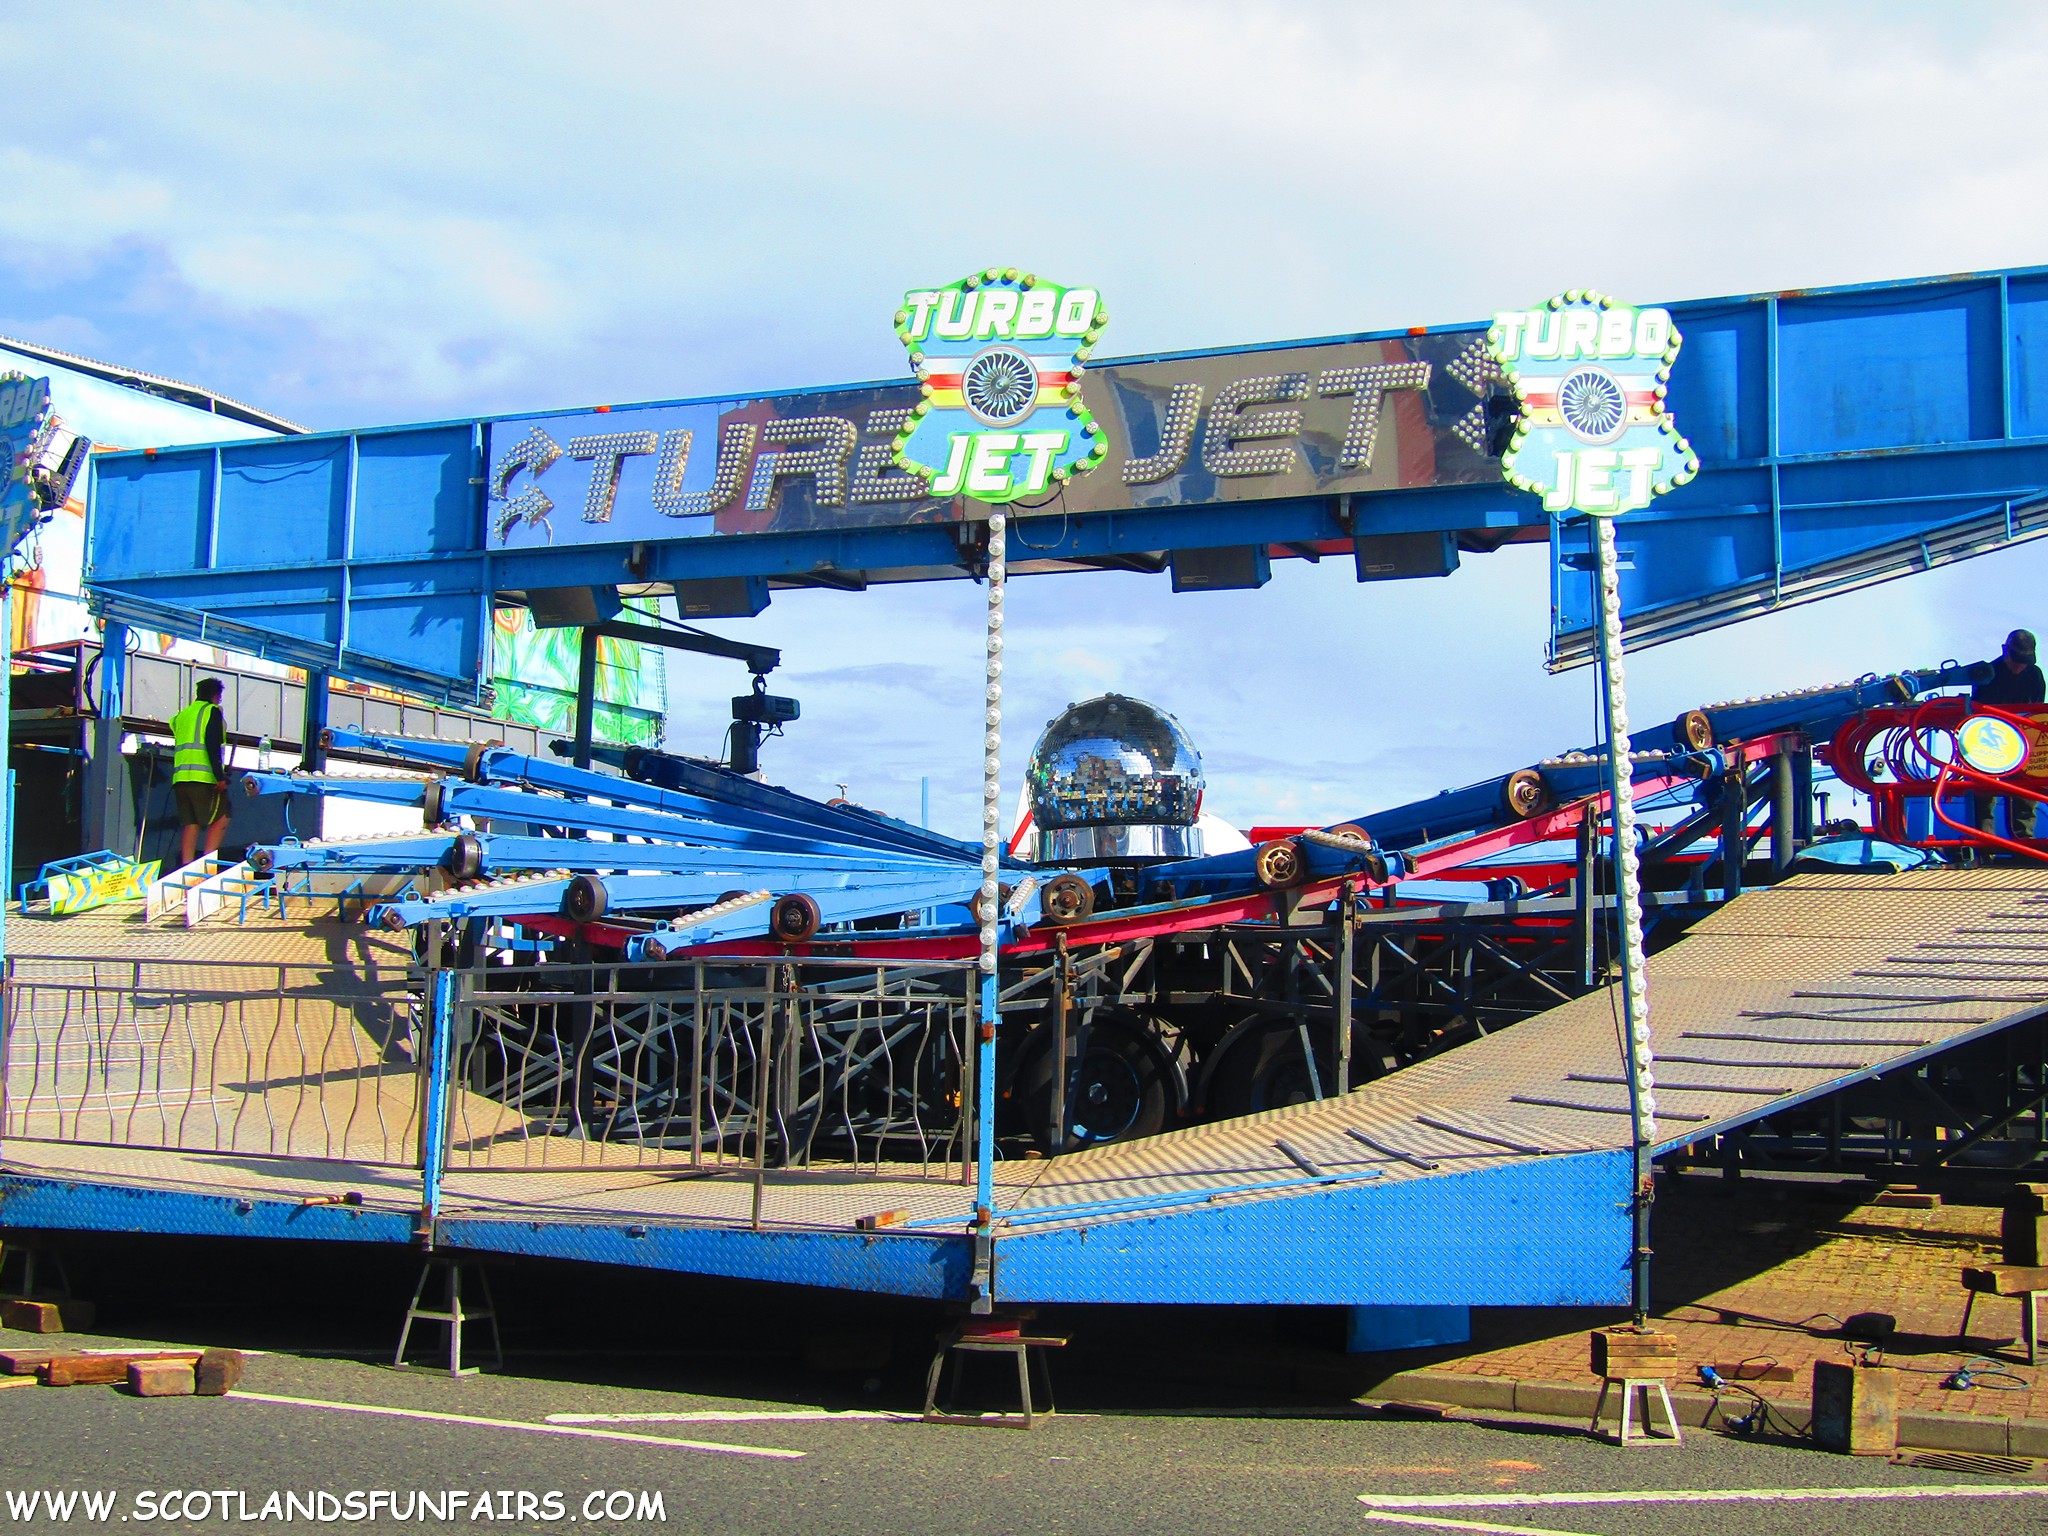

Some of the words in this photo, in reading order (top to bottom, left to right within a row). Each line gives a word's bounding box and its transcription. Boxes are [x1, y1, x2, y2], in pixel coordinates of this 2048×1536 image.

[906, 289, 1098, 337] TURBO
[1493, 309, 1671, 357] TURBO
[0, 379, 47, 427] RBO
[566, 408, 932, 523] TURB
[1121, 360, 1432, 482] JET
[932, 433, 1067, 493] JET
[1545, 450, 1661, 508] JET
